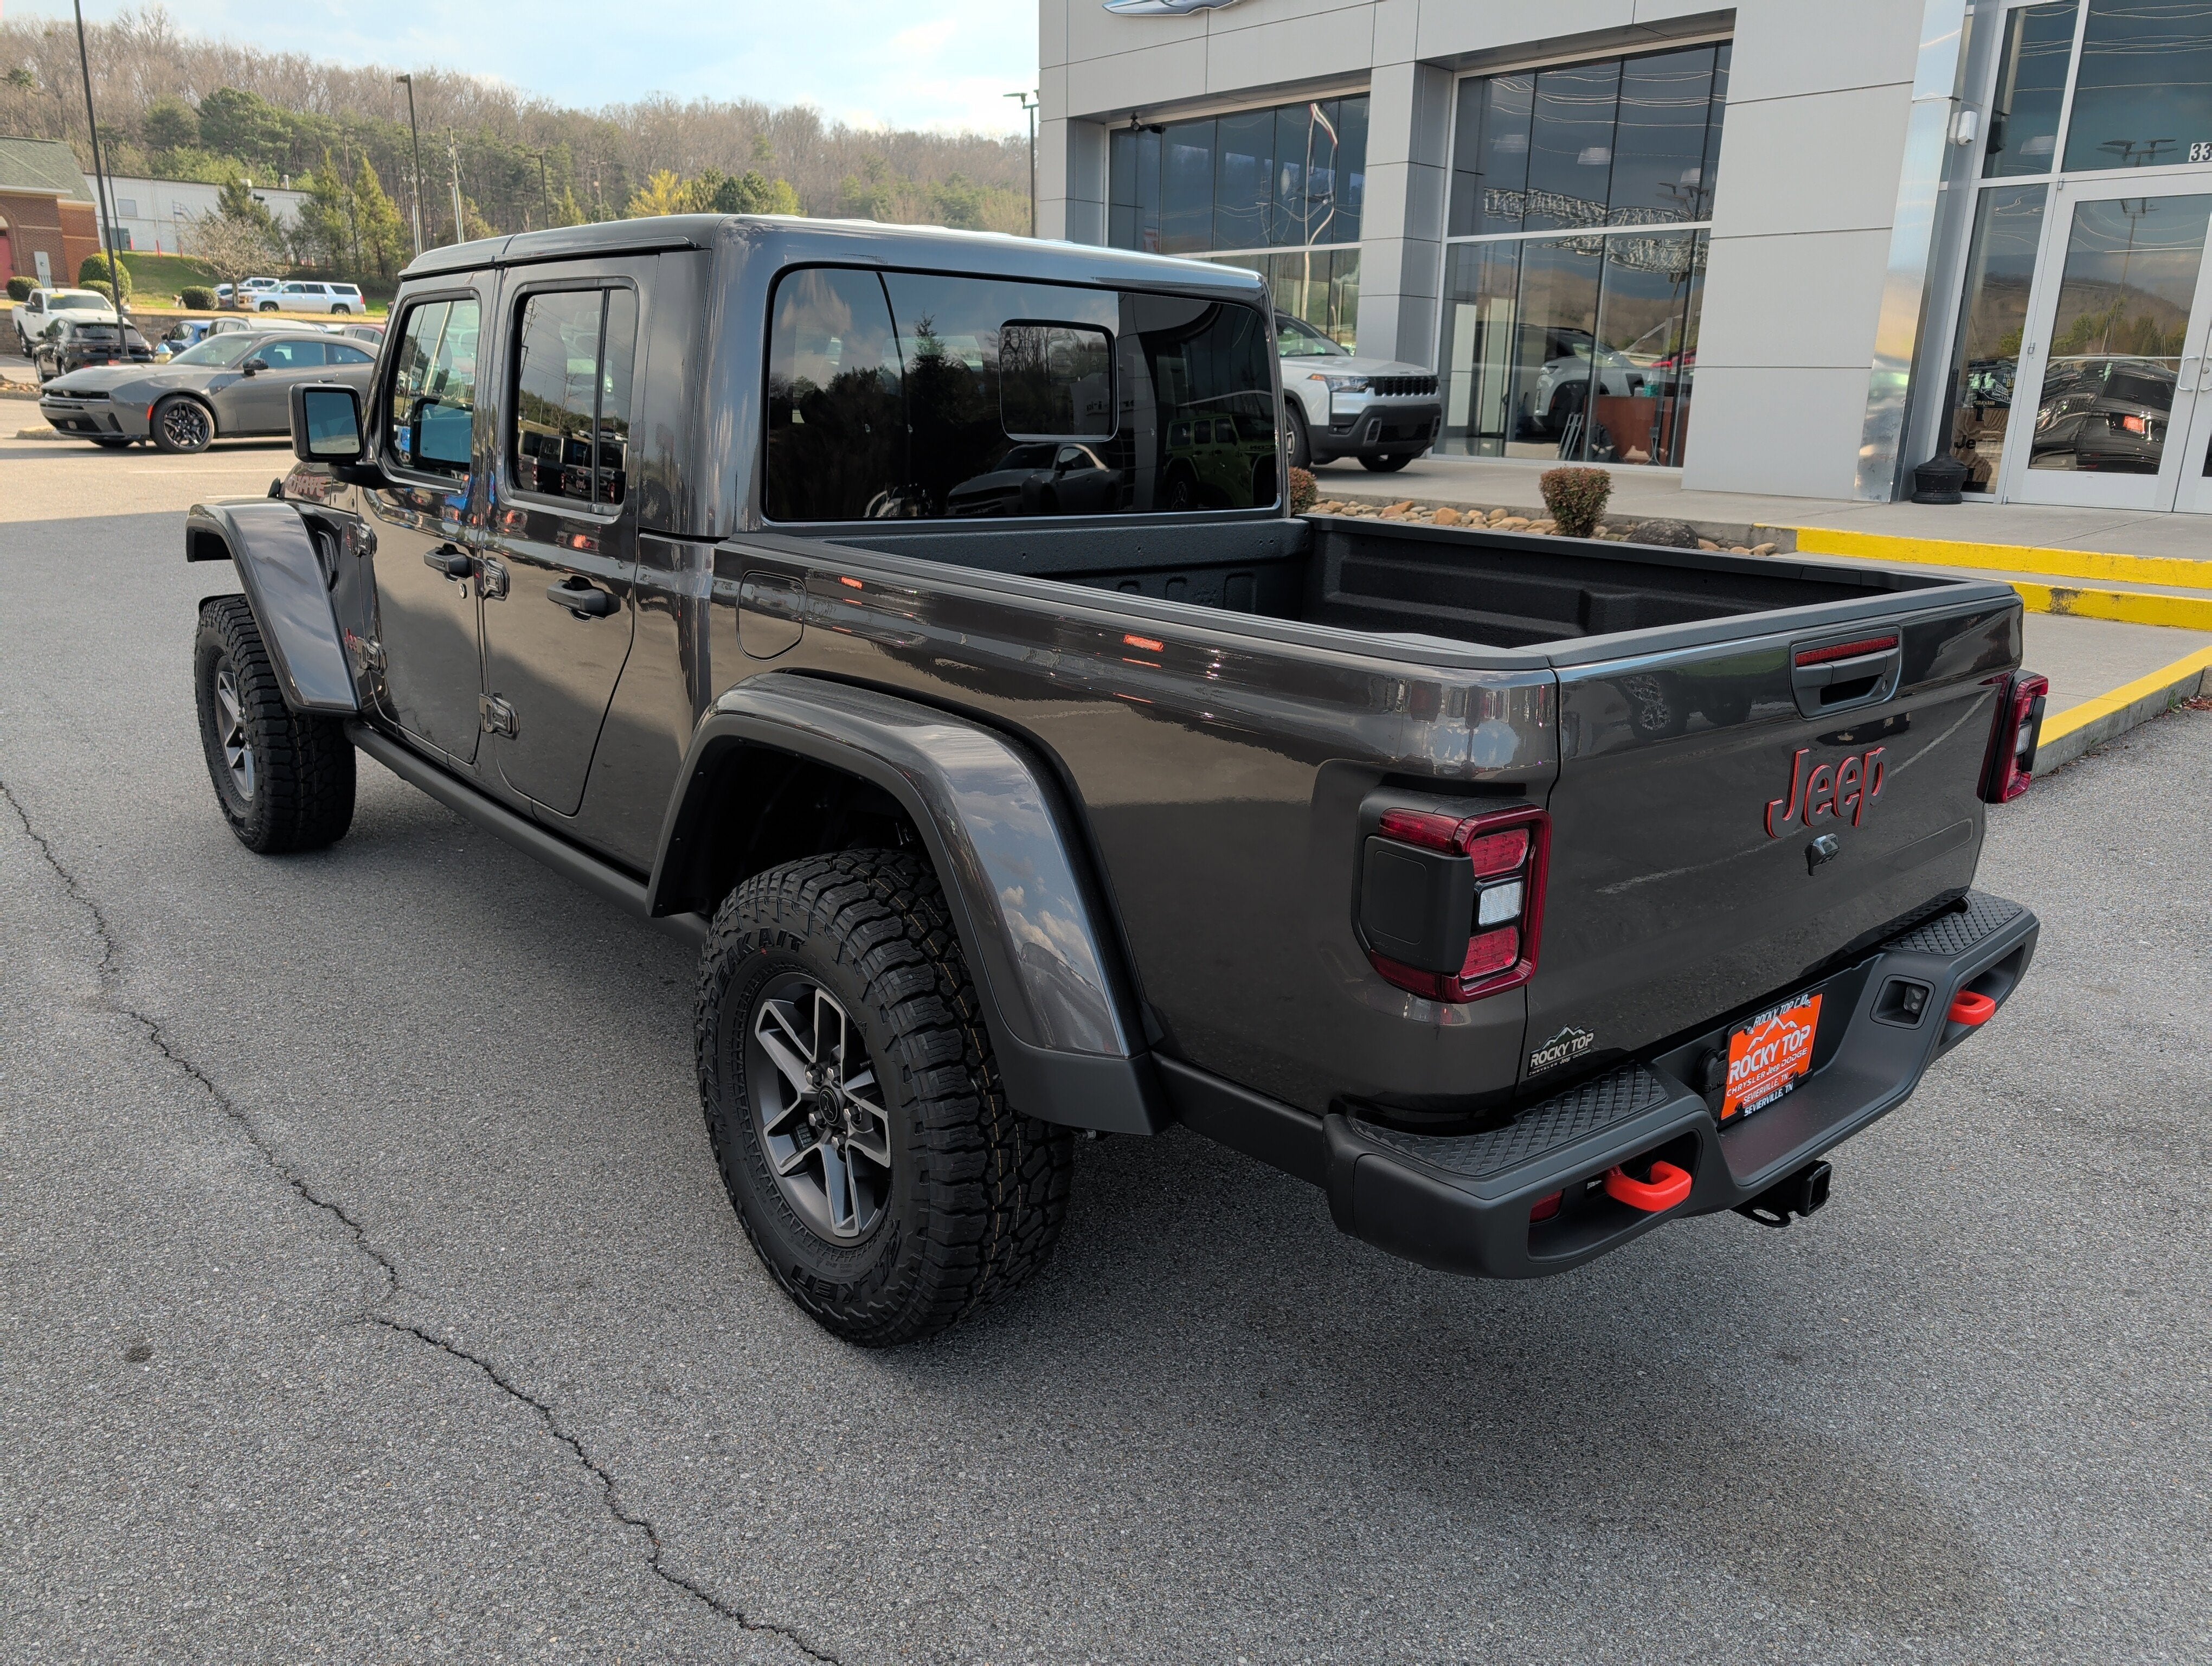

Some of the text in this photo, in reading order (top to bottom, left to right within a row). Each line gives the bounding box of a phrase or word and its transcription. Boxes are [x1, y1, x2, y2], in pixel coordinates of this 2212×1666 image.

[1764, 746, 1890, 839] Jeep
[1753, 1007, 1779, 1028] ROCKY
[1779, 1001, 1794, 1016] TOP
[1530, 1032, 1594, 1067] ROCKY TOP
[1728, 1024, 1811, 1085] ROCKY TOP
[1727, 1047, 1808, 1097] CHRYSLER Jeep DODGE
[1743, 1072, 1789, 1105] SEVIERVILLE, TN
[1744, 1082, 1793, 1117] SEVIERVILLE, TN
